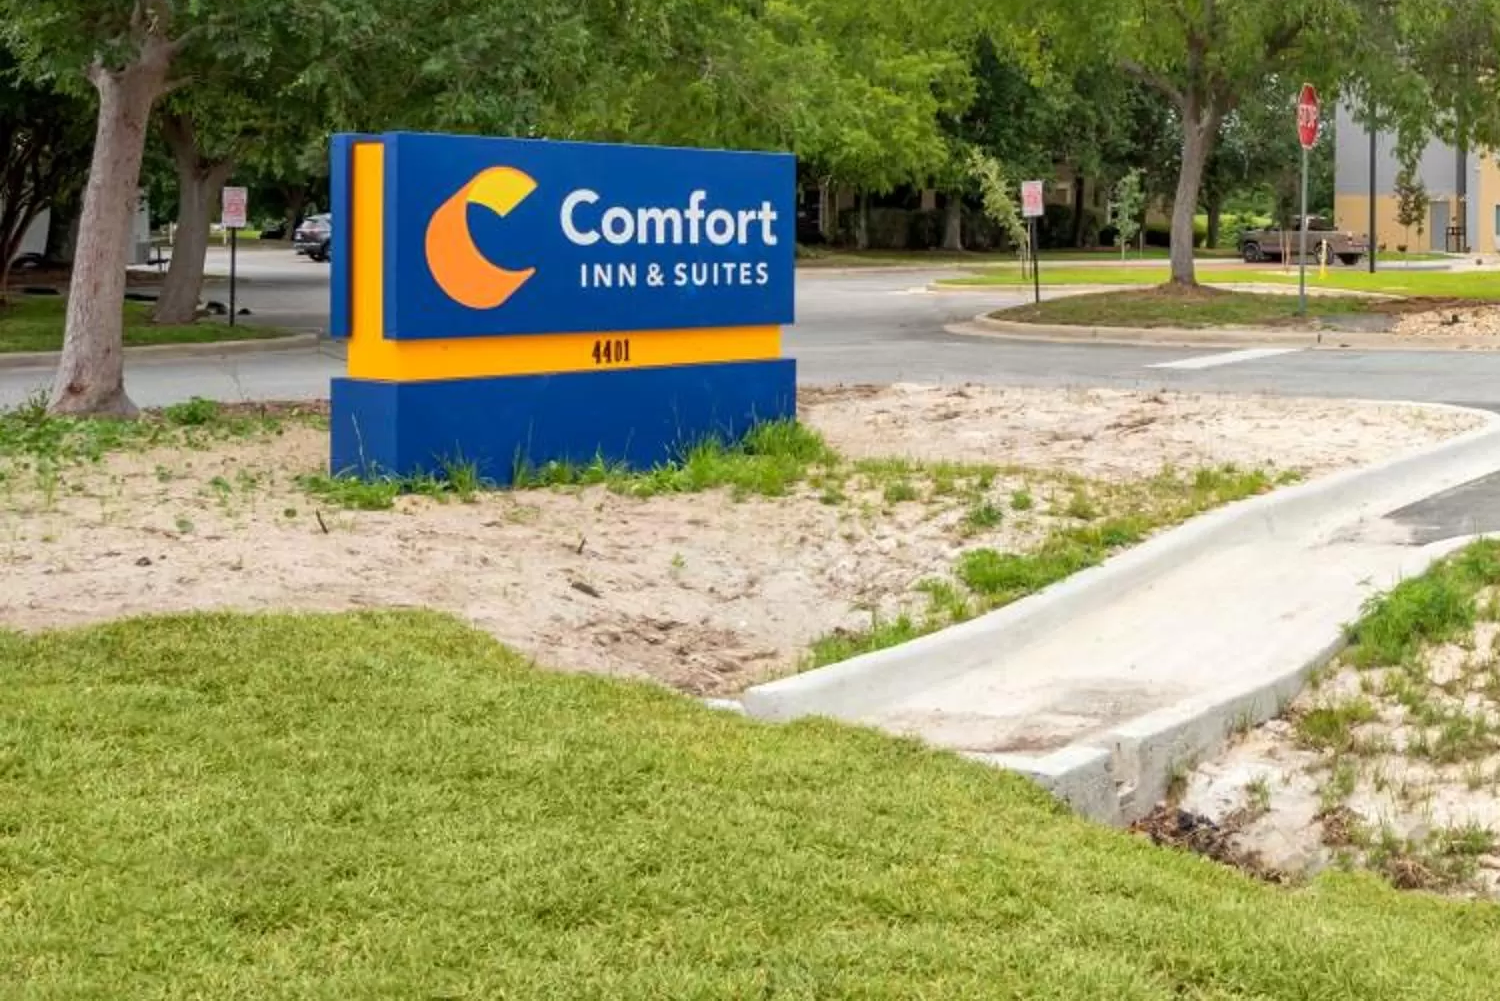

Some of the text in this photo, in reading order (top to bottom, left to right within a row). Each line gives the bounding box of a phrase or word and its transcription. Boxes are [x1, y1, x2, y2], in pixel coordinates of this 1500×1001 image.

[560, 188, 778, 246] Comfort
[580, 261, 769, 288] INN & SUITES
[592, 339, 630, 364] 4401
